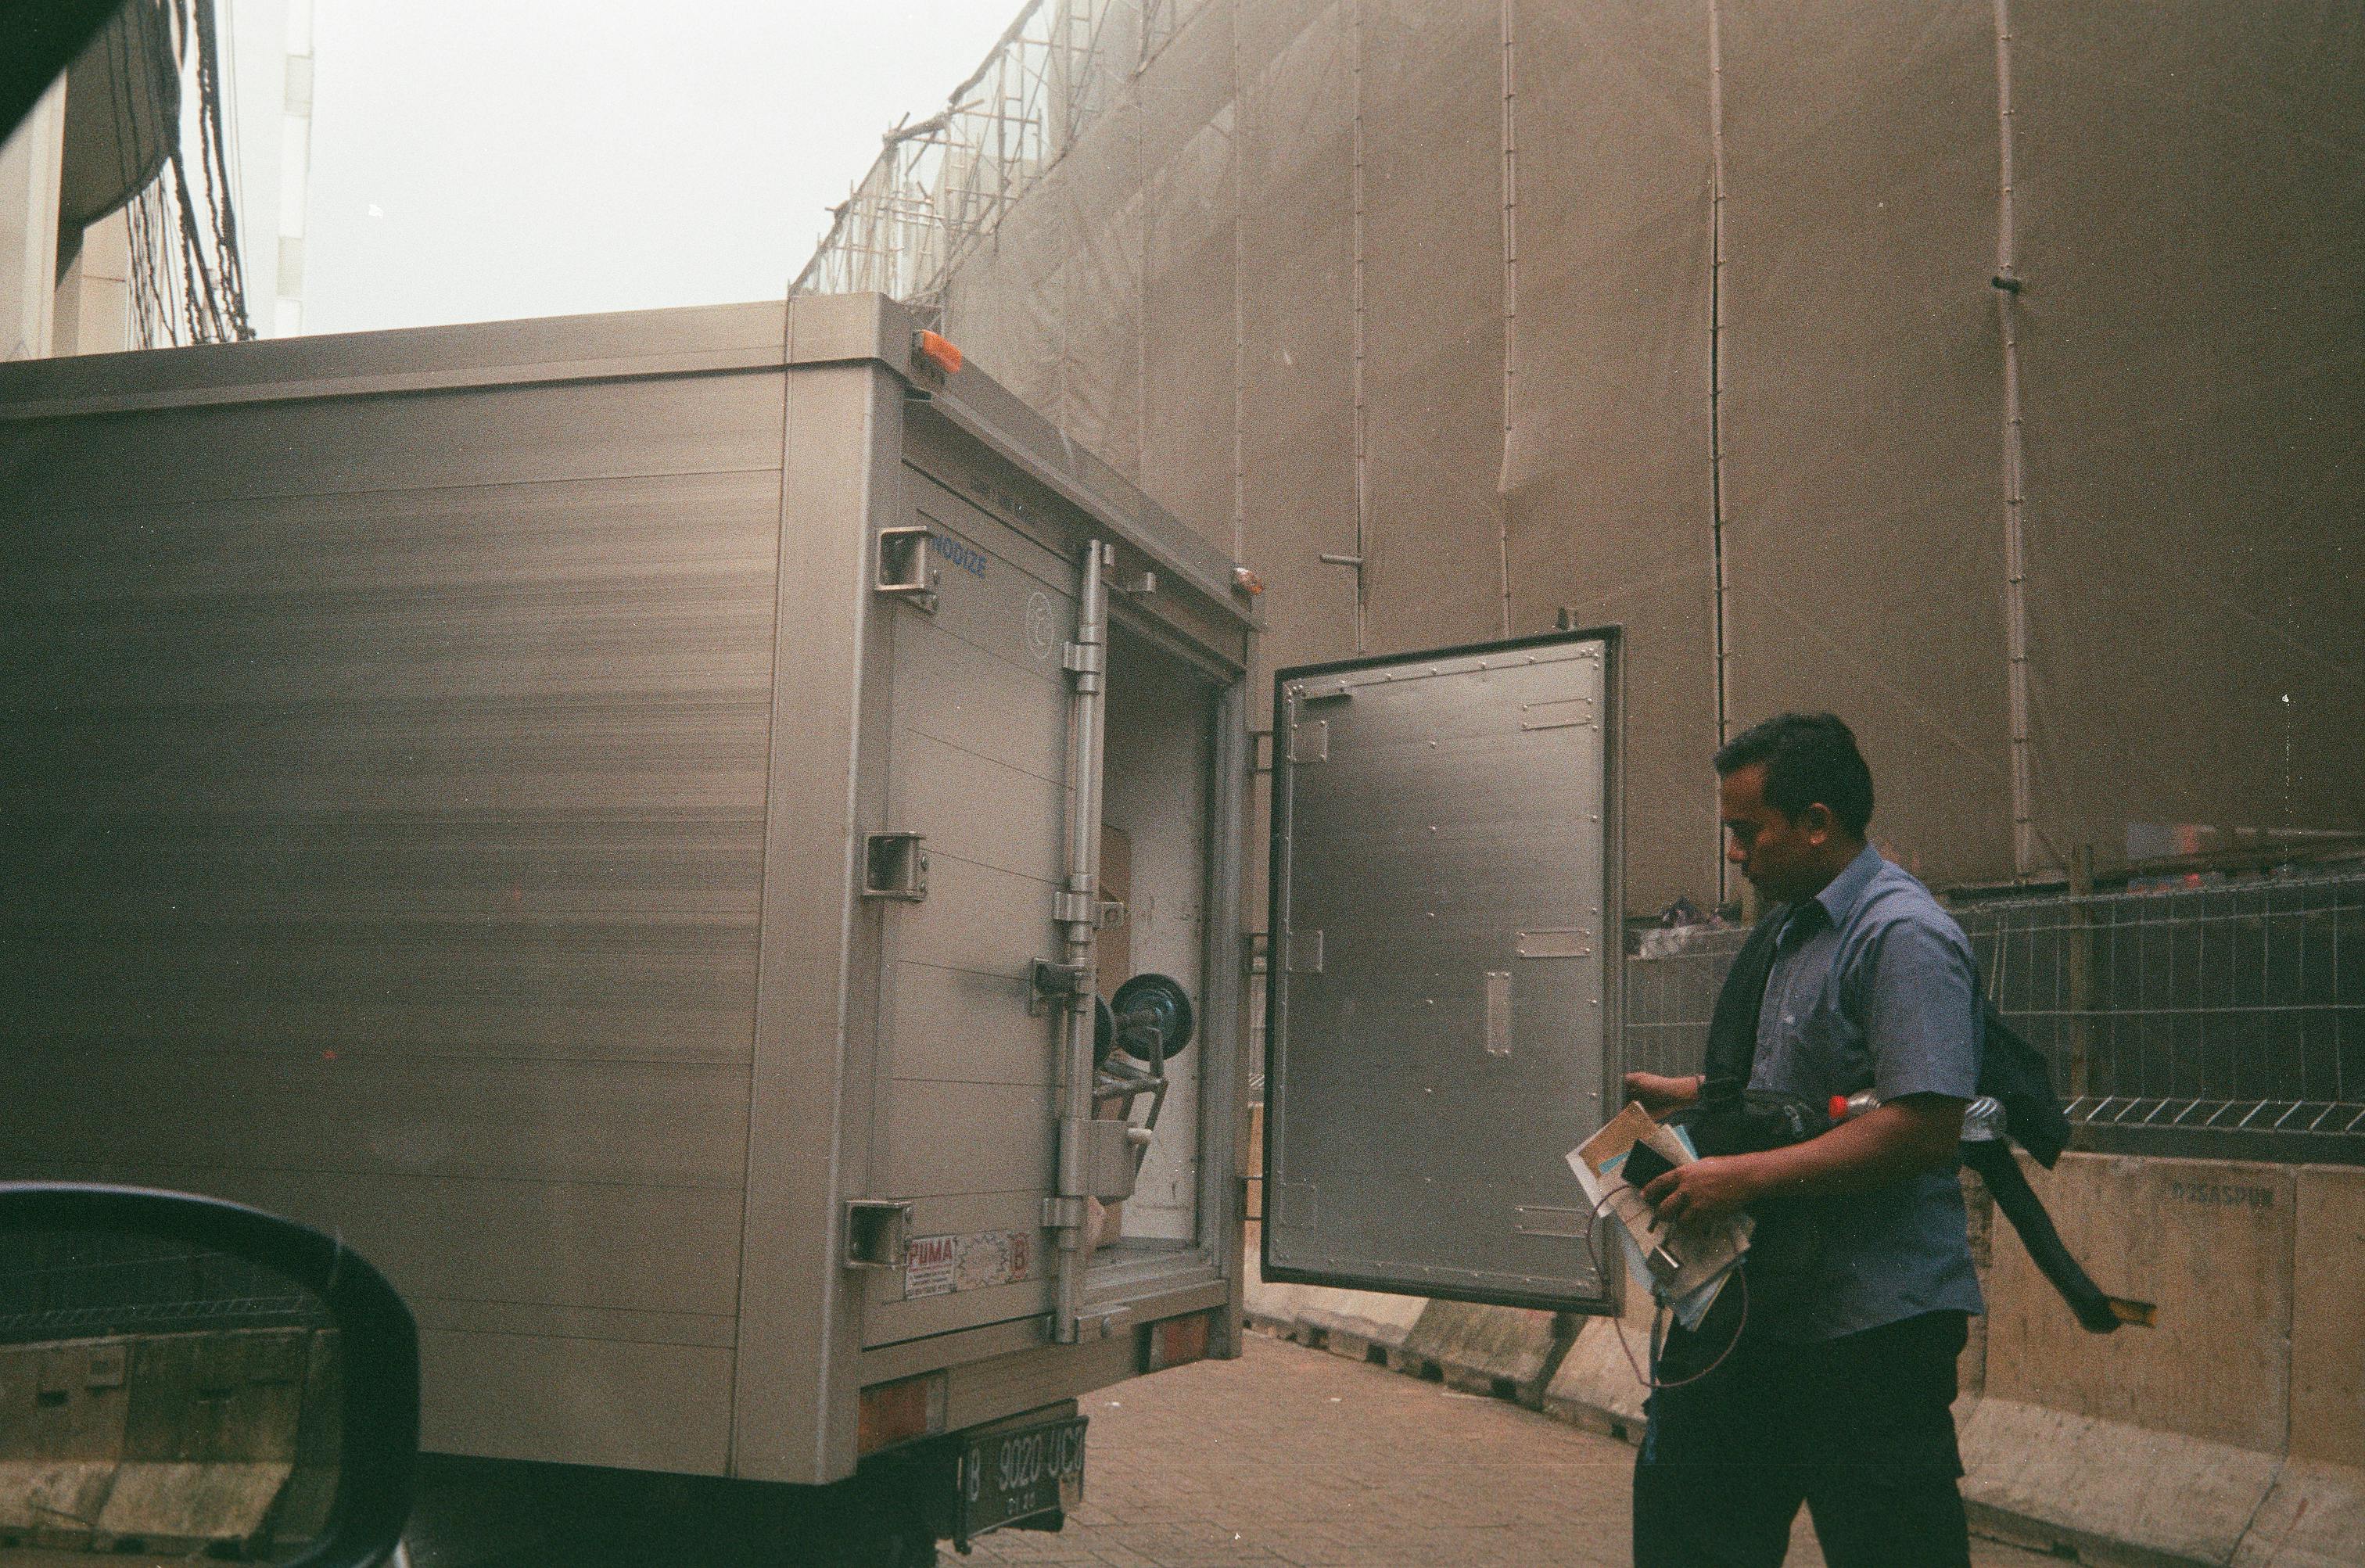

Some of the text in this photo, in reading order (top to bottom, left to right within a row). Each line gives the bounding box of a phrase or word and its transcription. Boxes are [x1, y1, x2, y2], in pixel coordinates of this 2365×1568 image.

[909, 1239, 953, 1265] PUMA
[971, 1448, 981, 1502] B
[999, 1434, 1043, 1491] 9020
